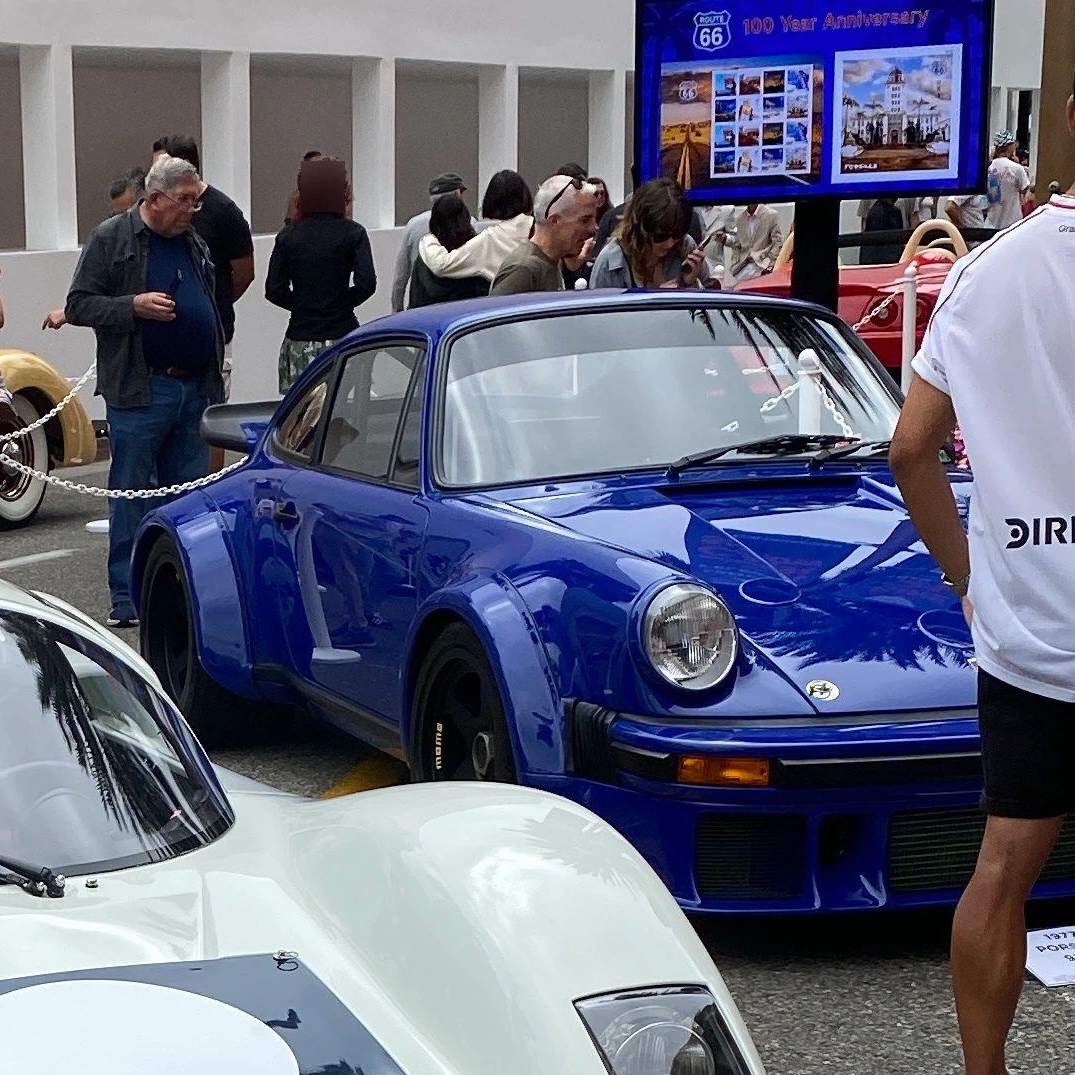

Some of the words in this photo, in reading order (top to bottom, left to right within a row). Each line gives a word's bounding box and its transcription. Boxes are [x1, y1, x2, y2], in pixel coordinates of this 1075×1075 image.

[699, 14, 724, 23] ROUTE
[743, 17, 774, 36] 100
[779, 15, 818, 33] Year
[822, 9, 929, 31] Anniversary
[699, 27, 723, 47] 66
[1004, 515, 1075, 549] DIR
